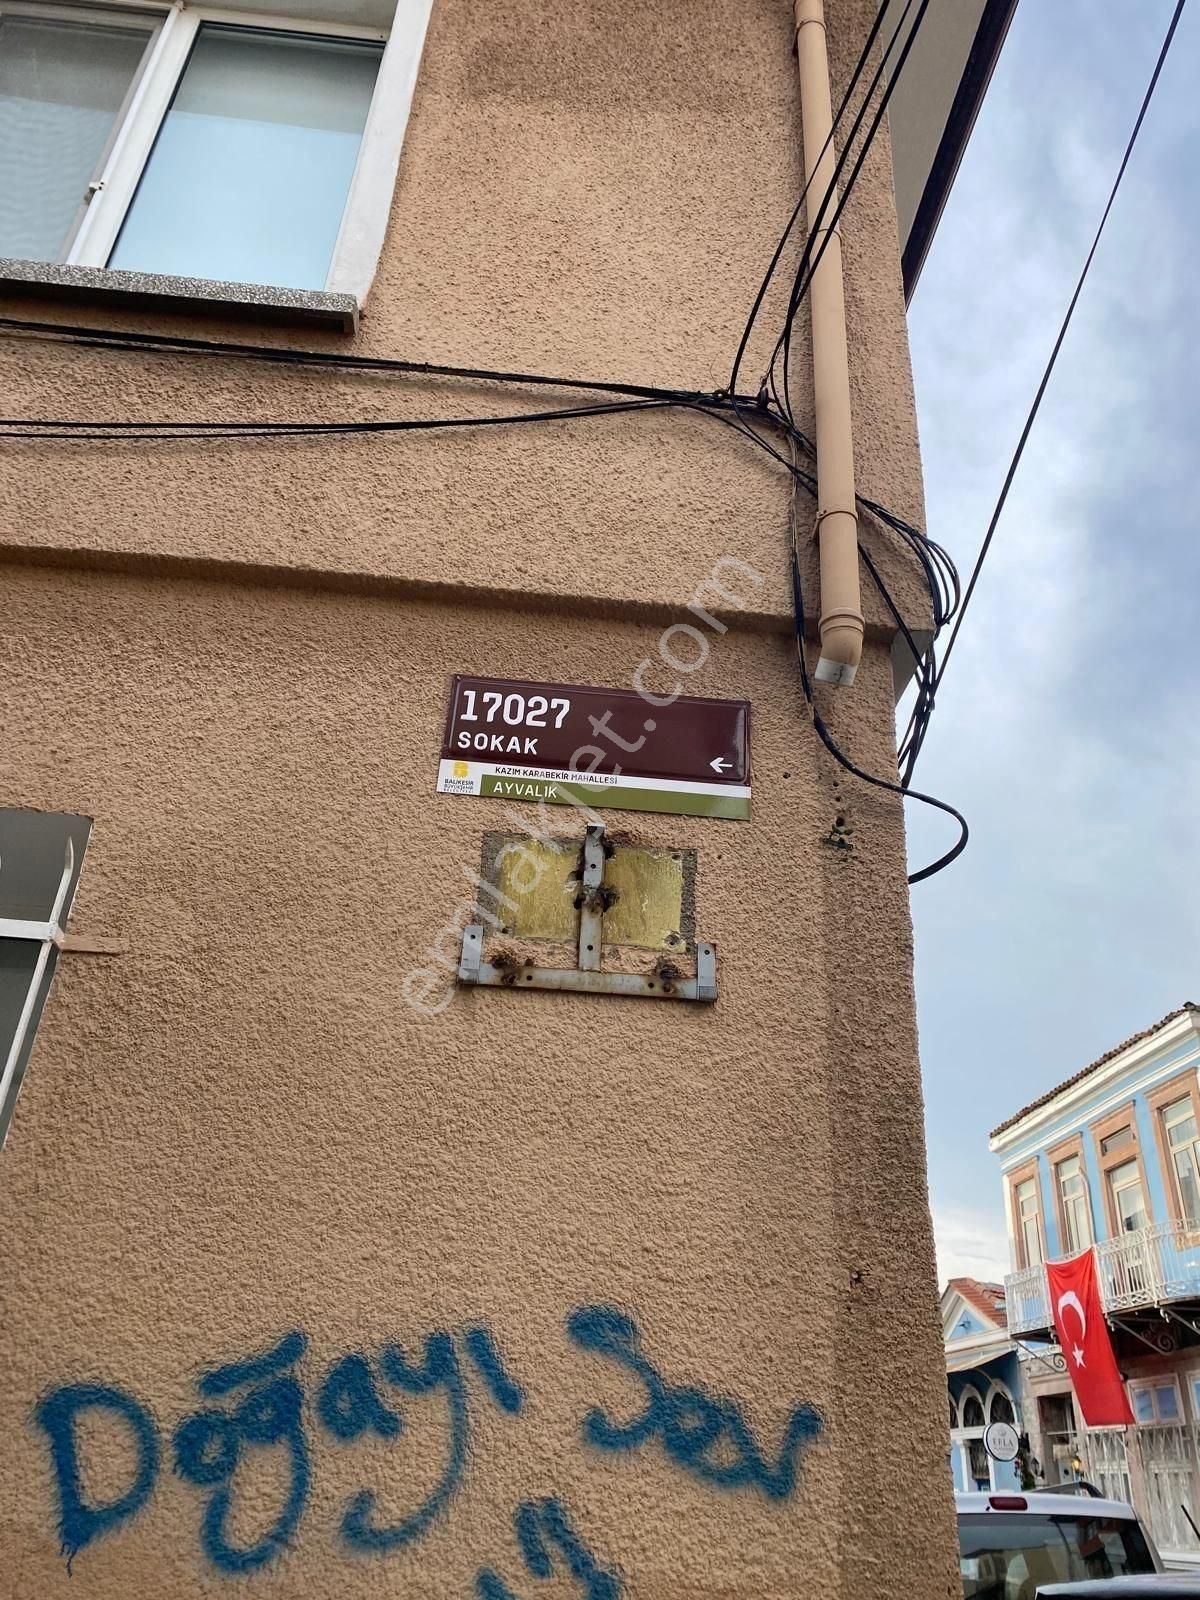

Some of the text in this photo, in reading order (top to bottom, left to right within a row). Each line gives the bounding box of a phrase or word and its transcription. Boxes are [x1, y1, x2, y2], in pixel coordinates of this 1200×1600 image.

[460, 690, 570, 729] 17027
[457, 731, 538, 755] SOKAK
[495, 766, 618, 785] KAZIM KARABEKİR MAHALLESİ
[493, 781, 558, 799] AYVALIK
